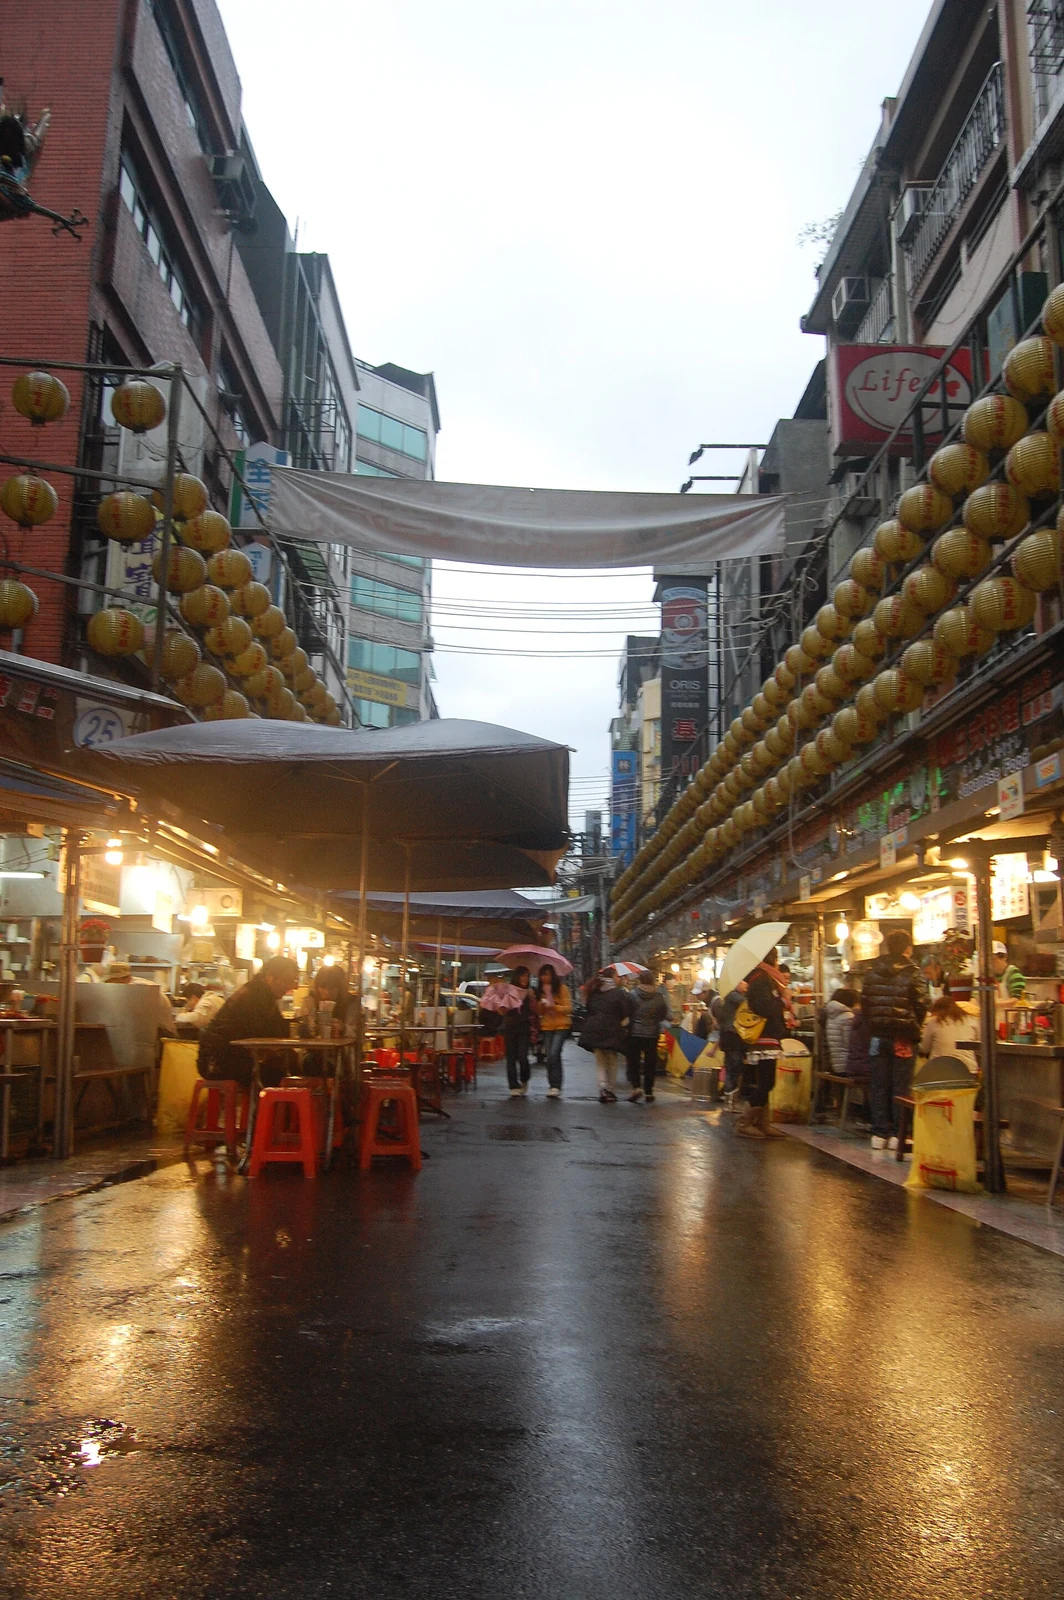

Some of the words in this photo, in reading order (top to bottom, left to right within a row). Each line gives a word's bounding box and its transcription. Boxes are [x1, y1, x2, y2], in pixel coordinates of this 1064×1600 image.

[669, 679, 701, 690] ORIS
[82, 714, 116, 746] 25
[1001, 746, 1031, 778] Food
